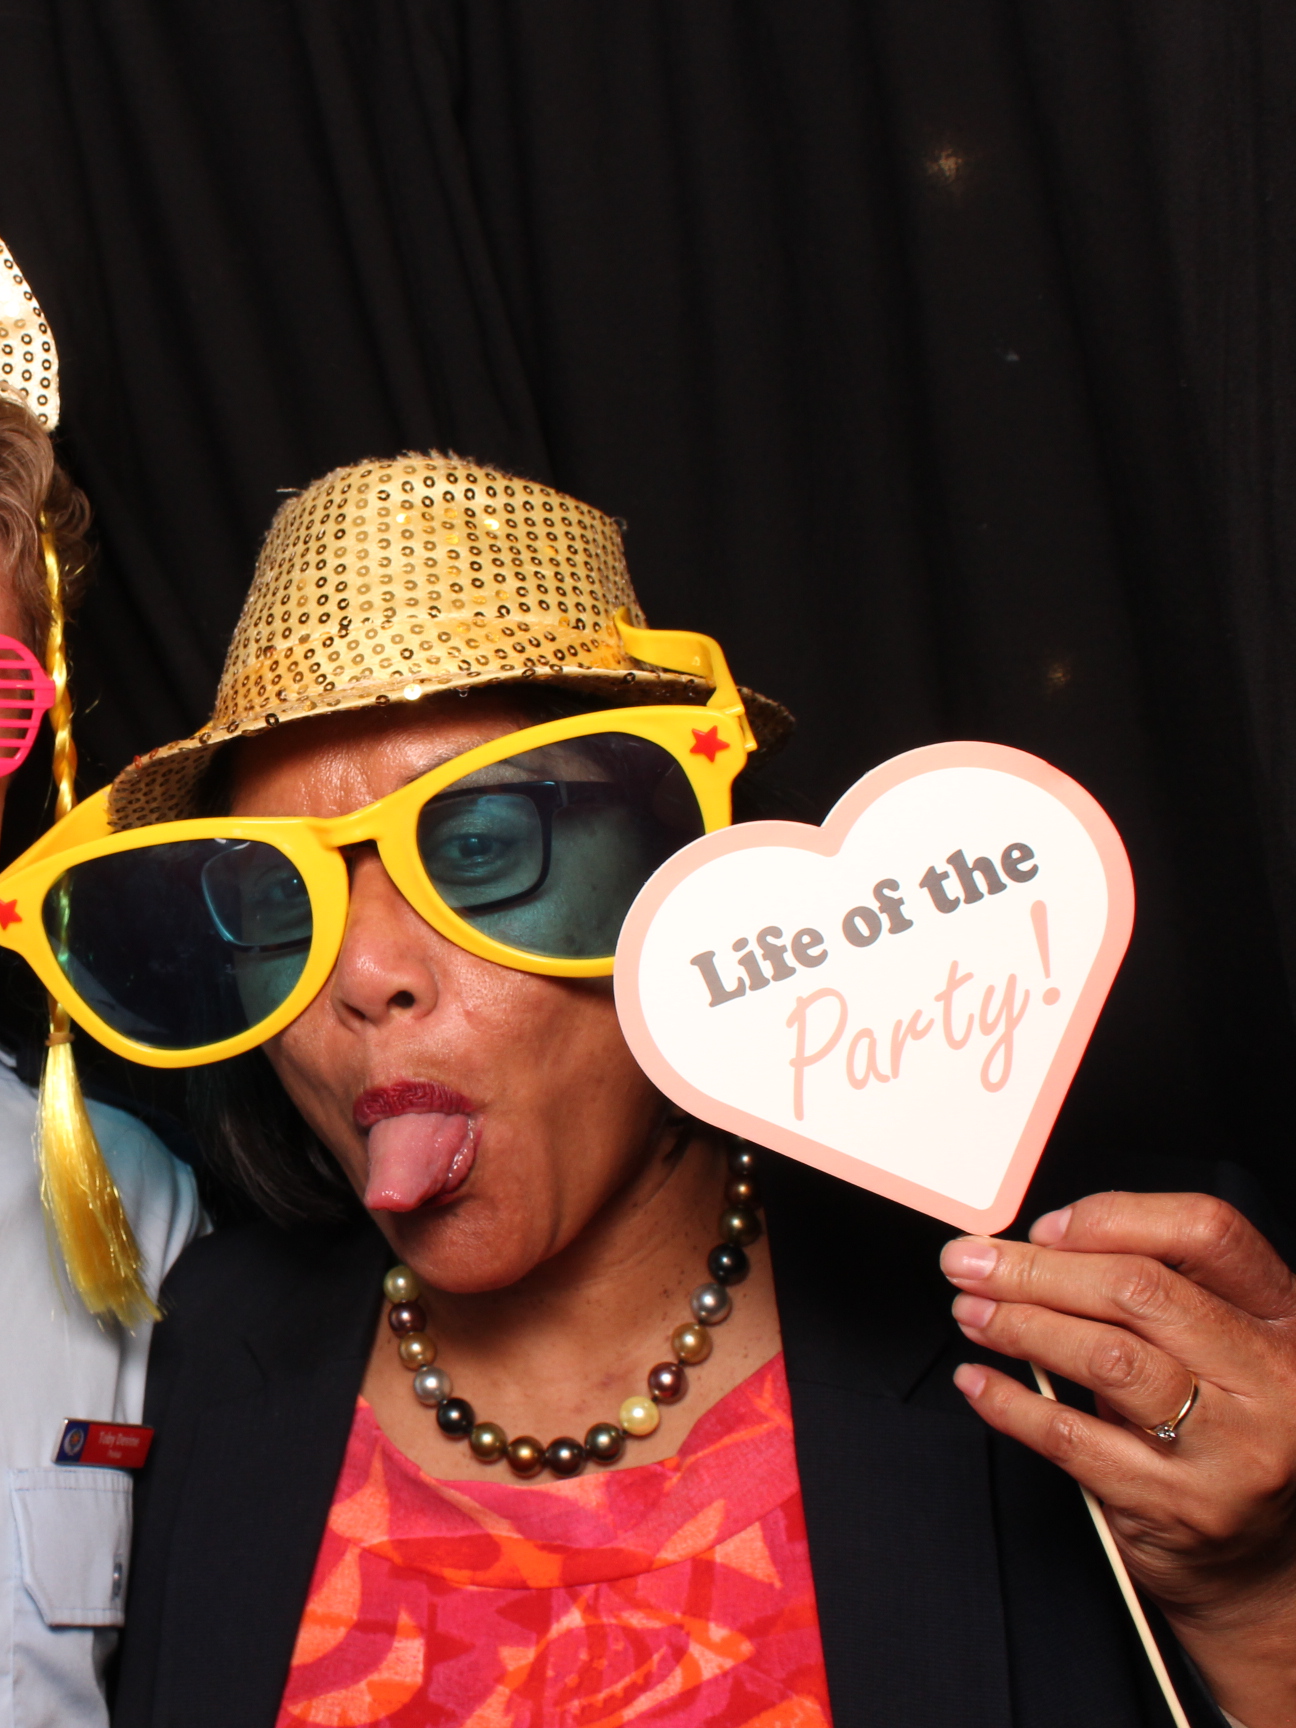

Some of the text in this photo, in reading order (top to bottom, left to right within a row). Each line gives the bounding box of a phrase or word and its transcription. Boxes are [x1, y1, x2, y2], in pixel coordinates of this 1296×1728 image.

[689, 842, 1040, 1008] Life of the
[785, 899, 1062, 1122] Party!
